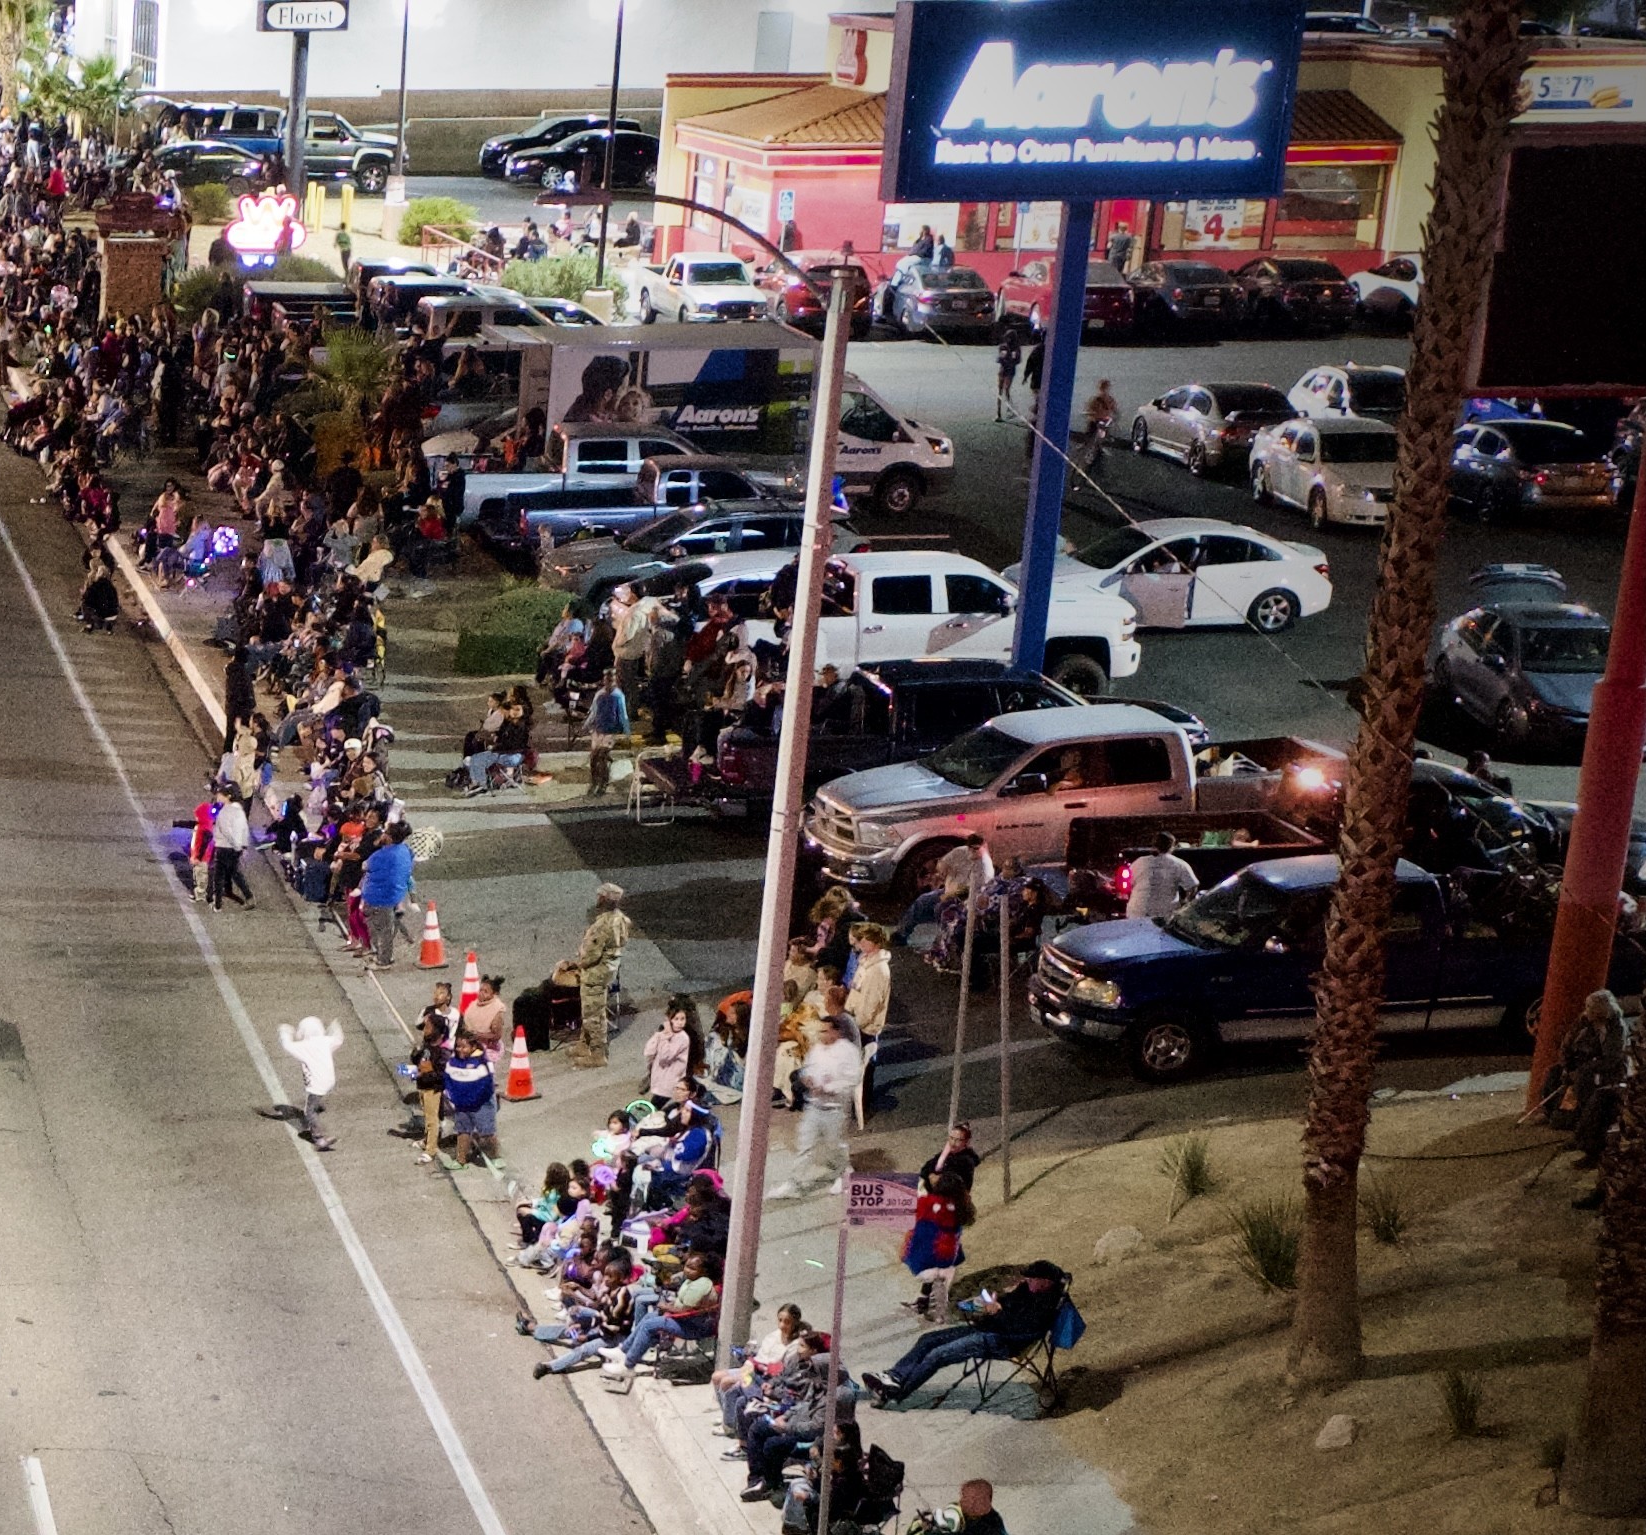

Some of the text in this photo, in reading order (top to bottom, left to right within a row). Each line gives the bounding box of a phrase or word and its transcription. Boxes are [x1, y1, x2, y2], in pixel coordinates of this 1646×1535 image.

[279, 6, 333, 24] Florist
[940, 41, 1264, 129] Aaron's
[1538, 76, 1551, 98] 5
[935, 138, 989, 164] Rent
[990, 139, 1016, 164] to
[1018, 138, 1071, 163] Own
[1072, 136, 1176, 163] Furniture
[1176, 136, 1195, 162] &
[676, 404, 760, 424] Aaron's
[851, 1184, 885, 1196] BUS
[850, 1197, 884, 1207] STOP
